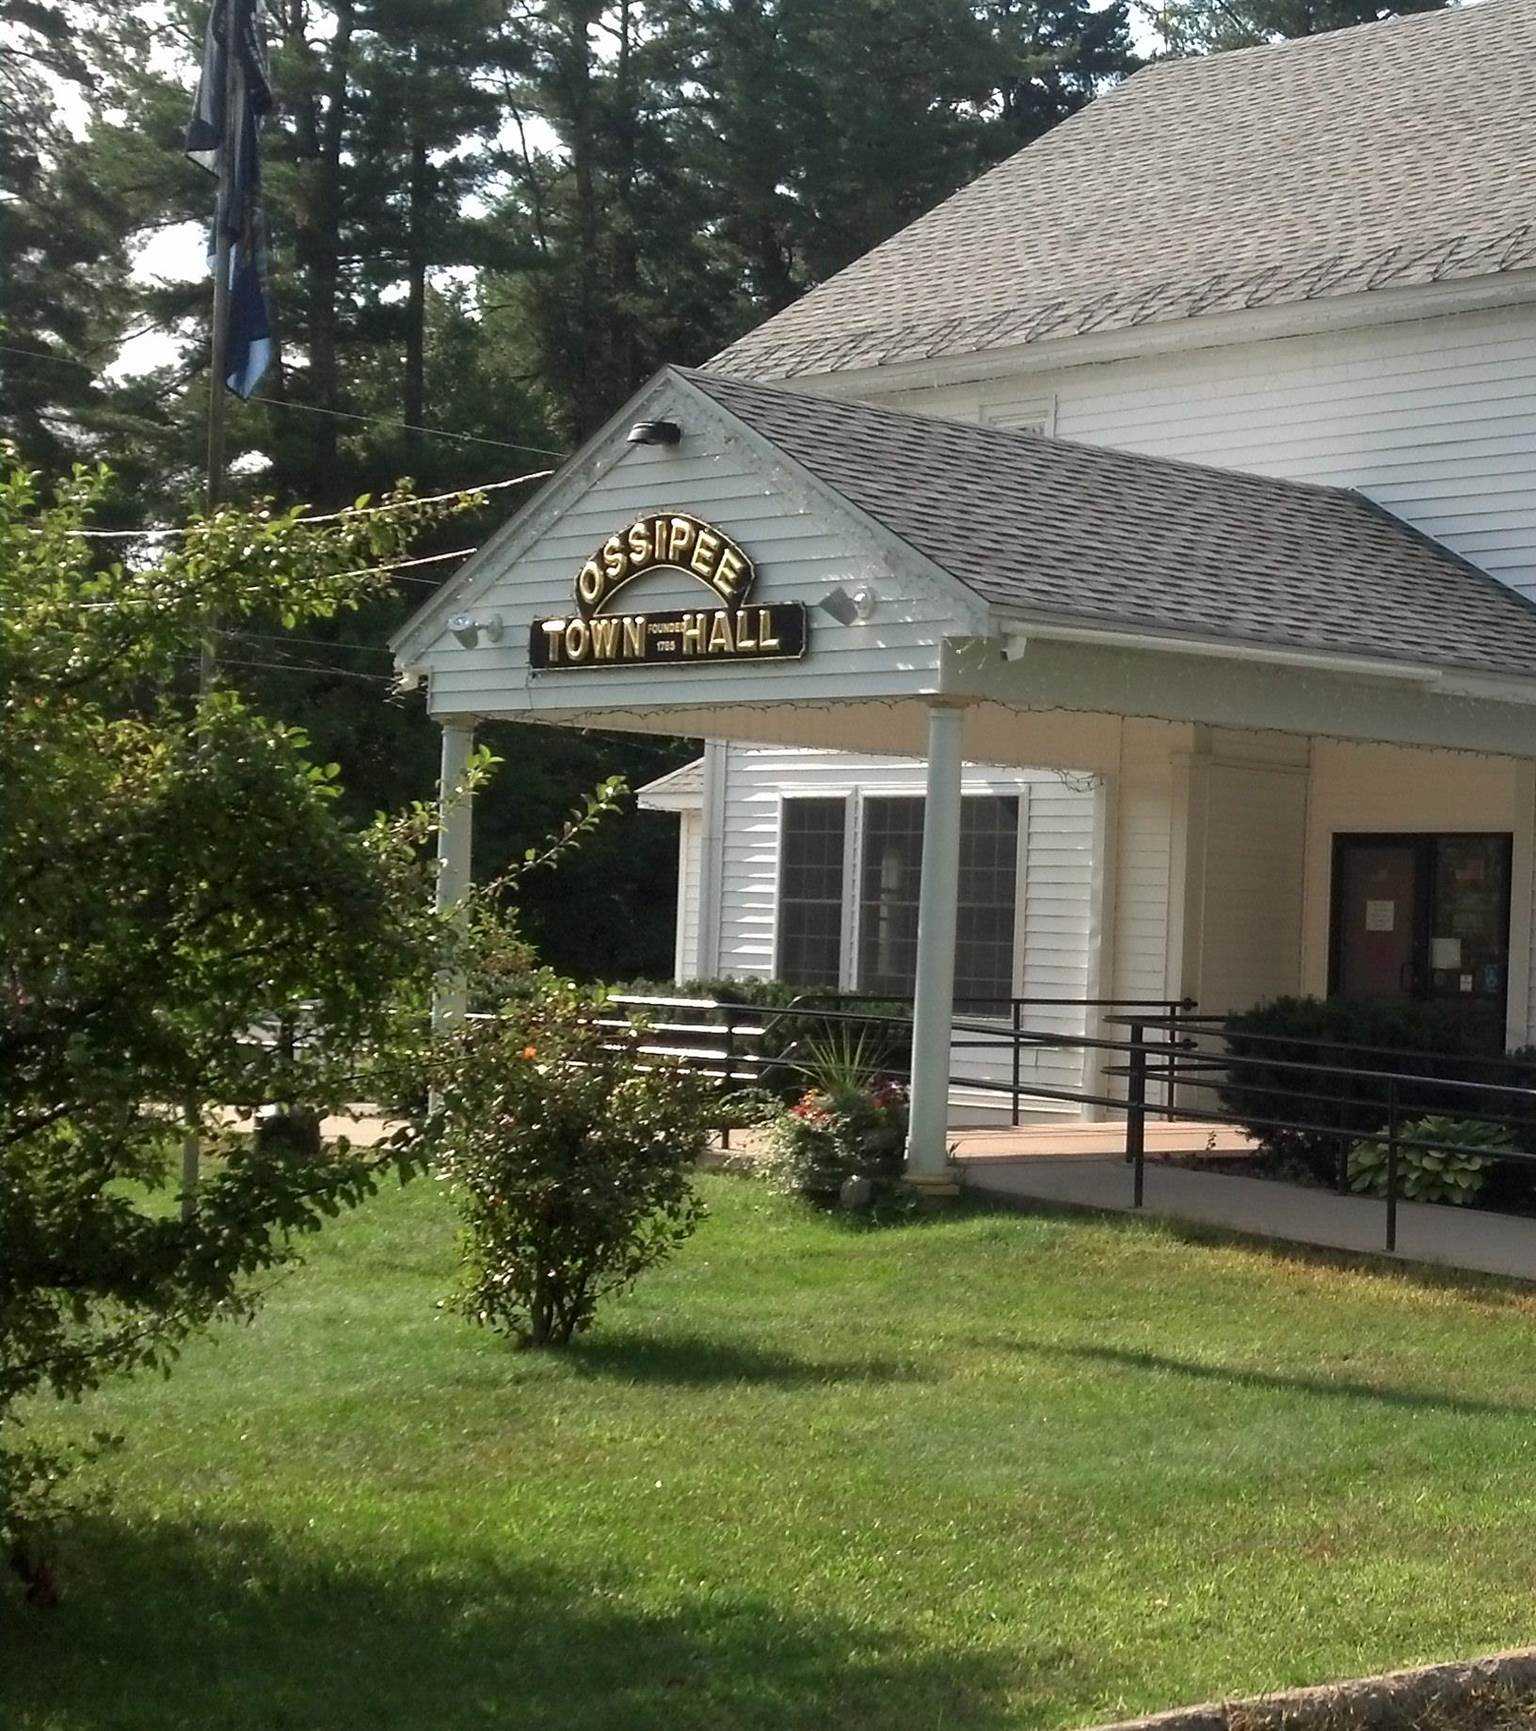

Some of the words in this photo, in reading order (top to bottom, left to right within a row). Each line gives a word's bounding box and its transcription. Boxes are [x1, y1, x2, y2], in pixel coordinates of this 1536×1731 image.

[577, 516, 747, 604] OSSIPEE
[541, 616, 647, 662] TOWN
[682, 610, 781, 655] HALL
[648, 622, 687, 633] FOUNDED
